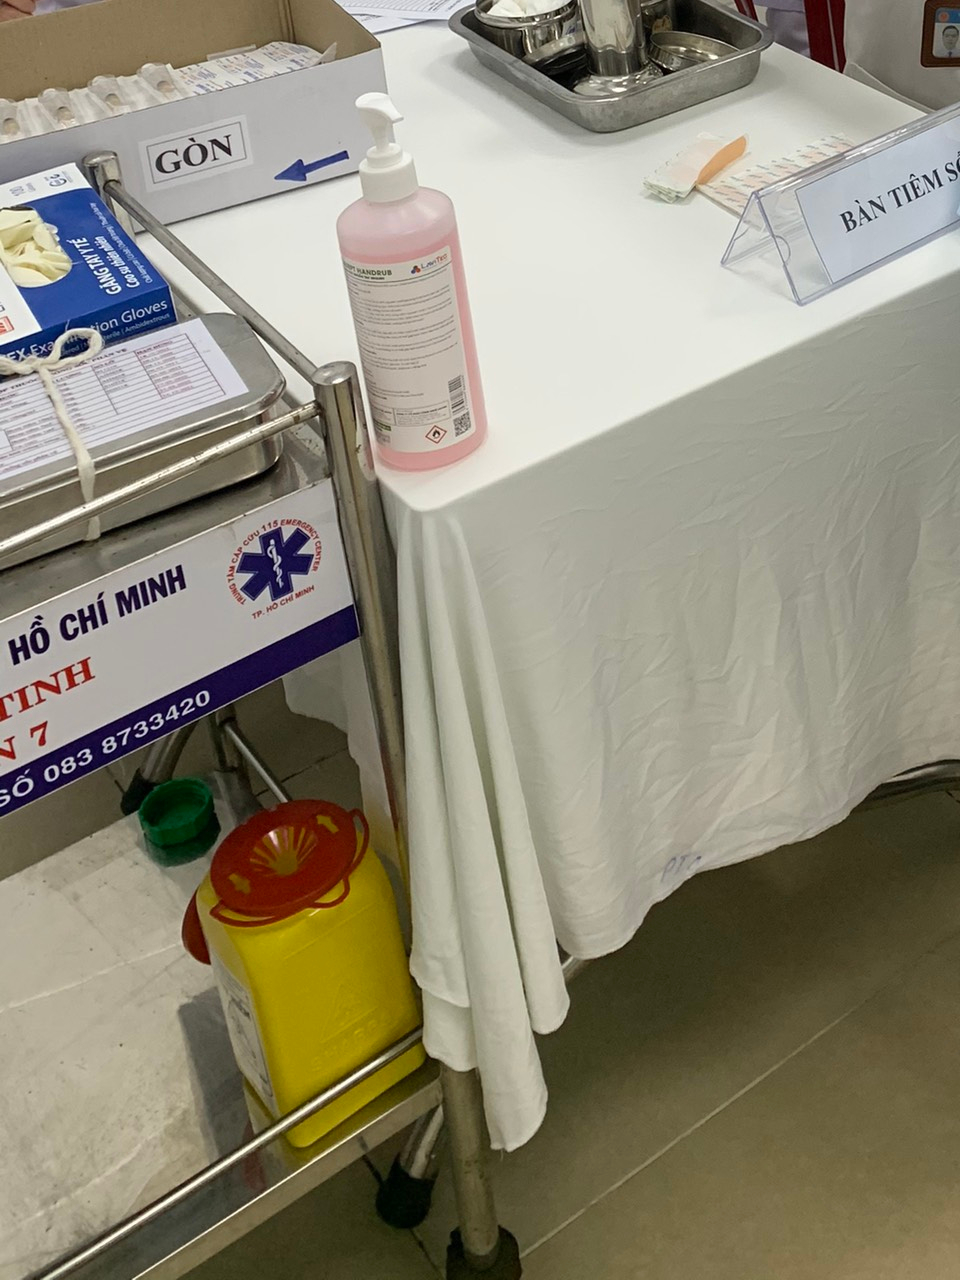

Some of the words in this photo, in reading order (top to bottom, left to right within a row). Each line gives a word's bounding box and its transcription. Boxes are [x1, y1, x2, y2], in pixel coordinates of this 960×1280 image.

[156, 134, 232, 174] GÒN
[839, 195, 888, 234] BÀN
[888, 169, 944, 209] TIÊM
[66, 236, 89, 249] TẾ
[83, 254, 105, 270] TAY
[357, 267, 392, 276] HANDRUB
[92, 266, 123, 295] GĂNG
[125, 273, 141, 288] Cao
[121, 300, 168, 324] Gloves
[229, 584, 247, 605] TRUNG
[261, 520, 278, 532] 115
[281, 519, 320, 540] EMERGENCY
[312, 541, 322, 572] CENTER
[280, 595, 294, 607] CHÍ
[295, 585, 315, 600] MINH
[8, 615, 50, 666] HỒ
[59, 591, 109, 641] CHÍ
[116, 565, 187, 618] MINH
[30, 721, 48, 748] 7
[44, 748, 93, 783] 083
[103, 690, 211, 755] 8733420
